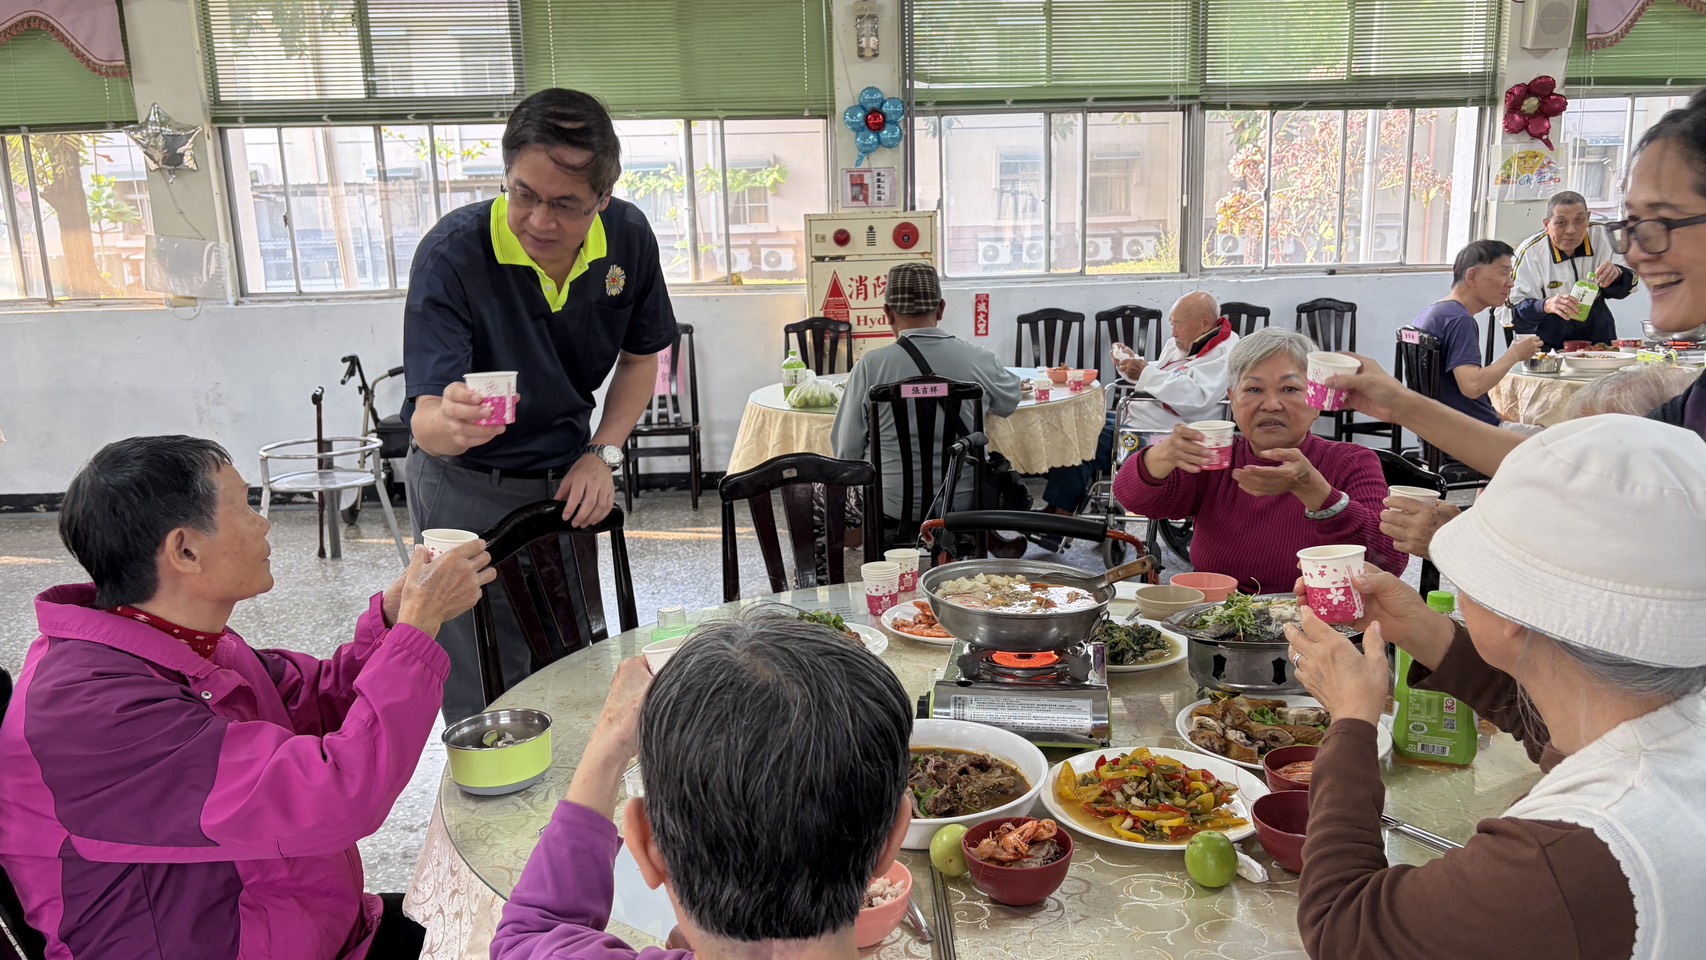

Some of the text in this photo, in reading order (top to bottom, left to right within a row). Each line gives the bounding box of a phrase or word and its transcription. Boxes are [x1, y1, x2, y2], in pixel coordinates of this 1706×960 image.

[848, 275, 887, 301] 消防
[856, 315, 886, 328] Hyd
[976, 302, 988, 335] 滅火器
[911, 385, 939, 395] 張吉祥
